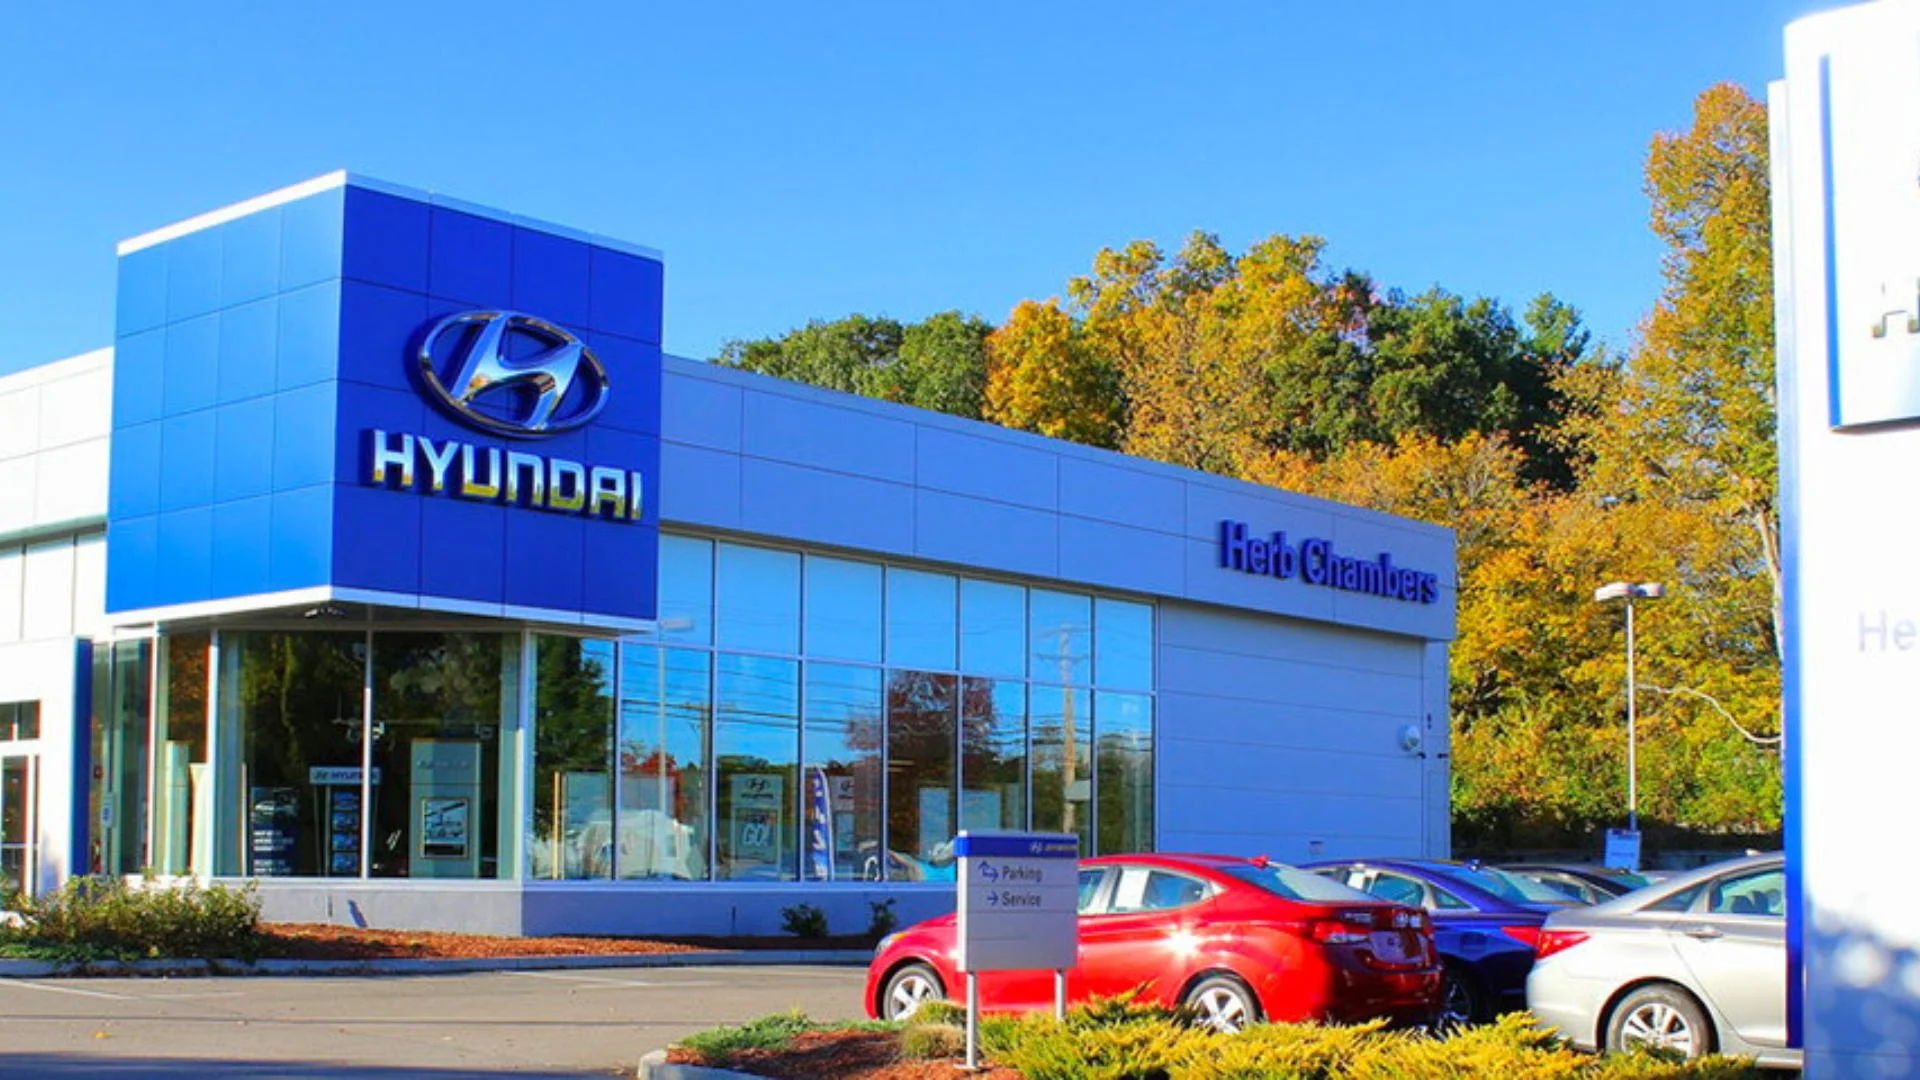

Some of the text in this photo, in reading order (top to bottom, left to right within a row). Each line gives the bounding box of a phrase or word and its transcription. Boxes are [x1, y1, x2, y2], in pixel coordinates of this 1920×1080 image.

[367, 429, 643, 521] HYUNDAI
[1219, 519, 1440, 604] Herb Chambers
[1002, 864, 1043, 883] Parking
[1002, 890, 1042, 907] Service
